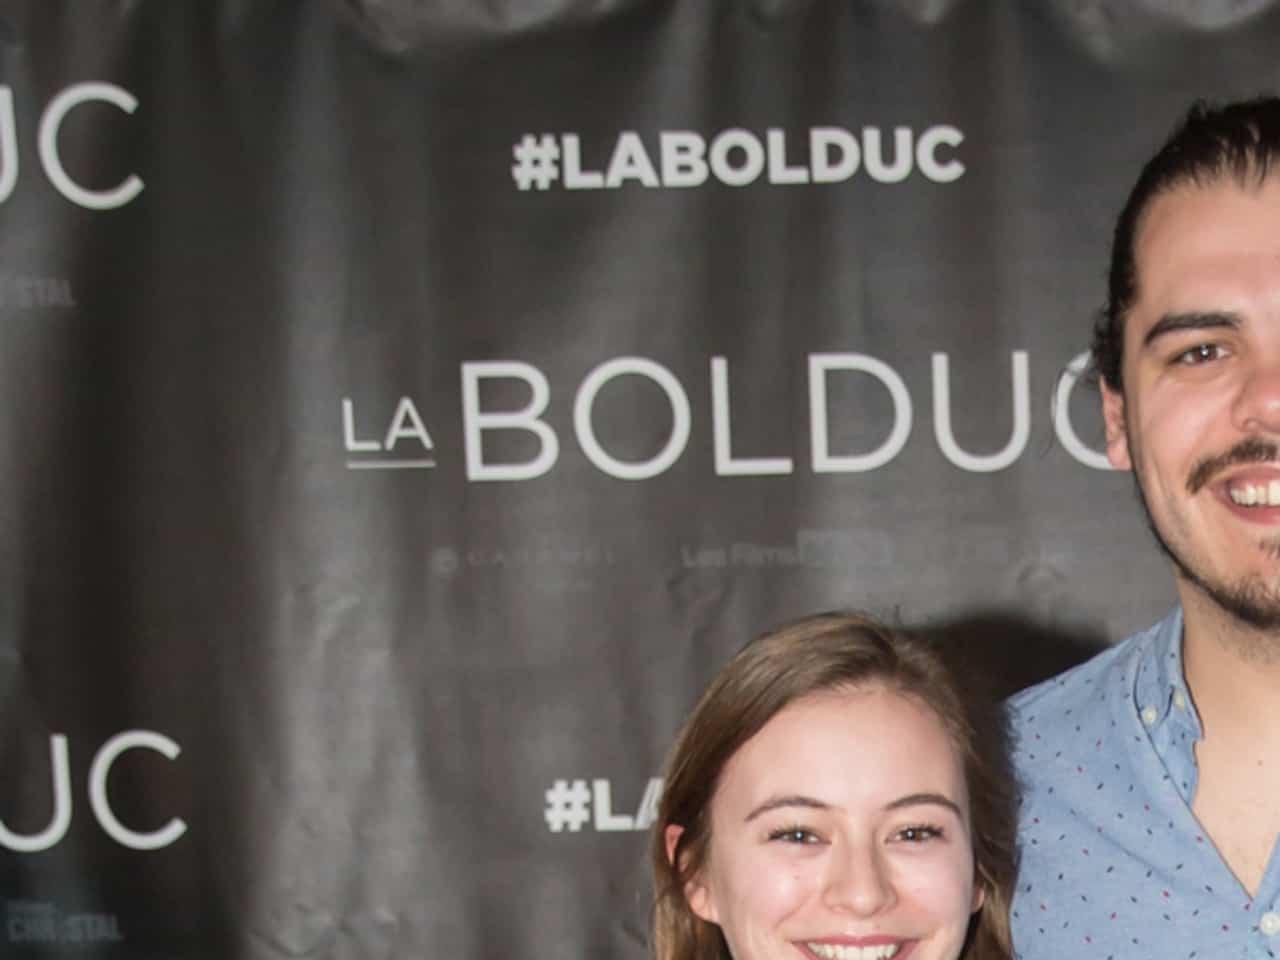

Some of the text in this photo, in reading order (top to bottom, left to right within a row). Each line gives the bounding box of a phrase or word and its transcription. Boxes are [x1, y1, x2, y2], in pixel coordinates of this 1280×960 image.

[512, 125, 965, 191] #LABOLDUC
[342, 351, 1108, 482] LA BOLDUC
